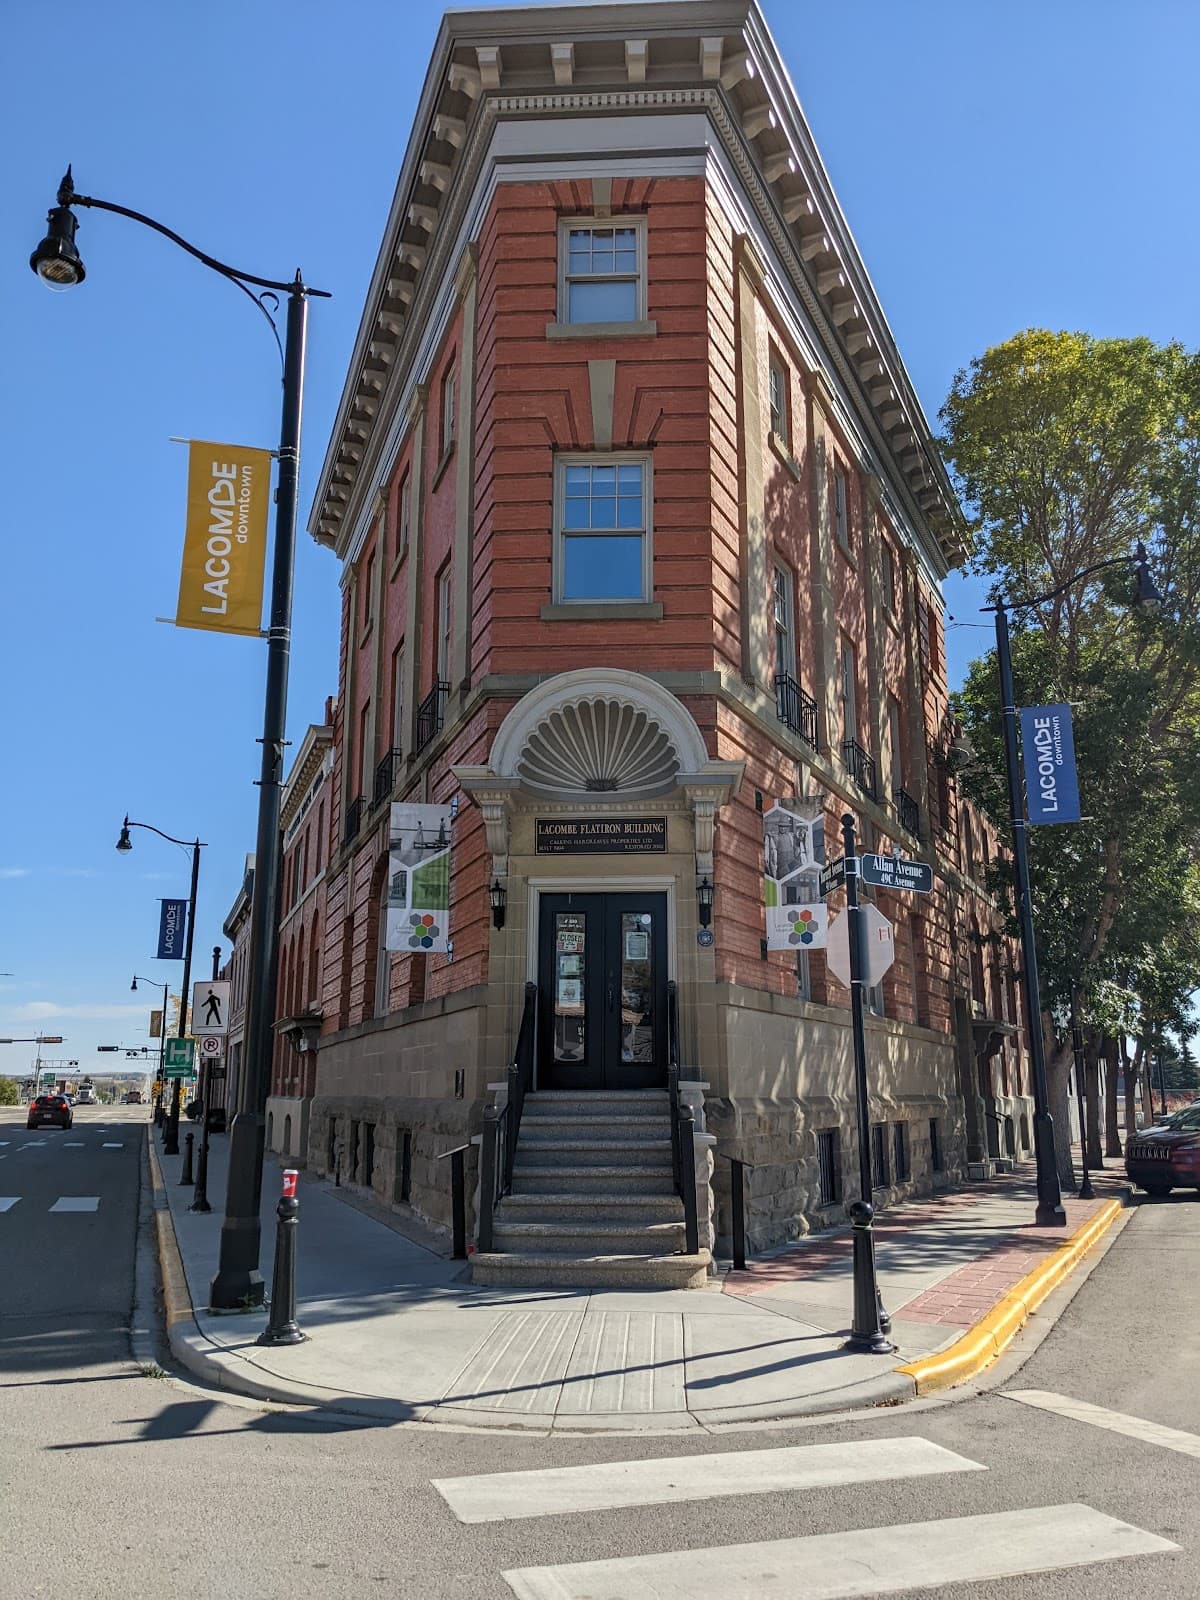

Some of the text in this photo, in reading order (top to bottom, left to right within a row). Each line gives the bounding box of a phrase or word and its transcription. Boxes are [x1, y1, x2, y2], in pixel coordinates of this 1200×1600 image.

[235, 465, 252, 544] downtown
[1052, 716, 1063, 766] downtown
[539, 823, 664, 834] LACOMBE FLATIRON BUILDING
[873, 856, 923, 878] Allan Avenue
[880, 873, 915, 888] 49C Avenue
[560, 934, 582, 942] CLOSED
[170, 1042, 193, 1062] H
